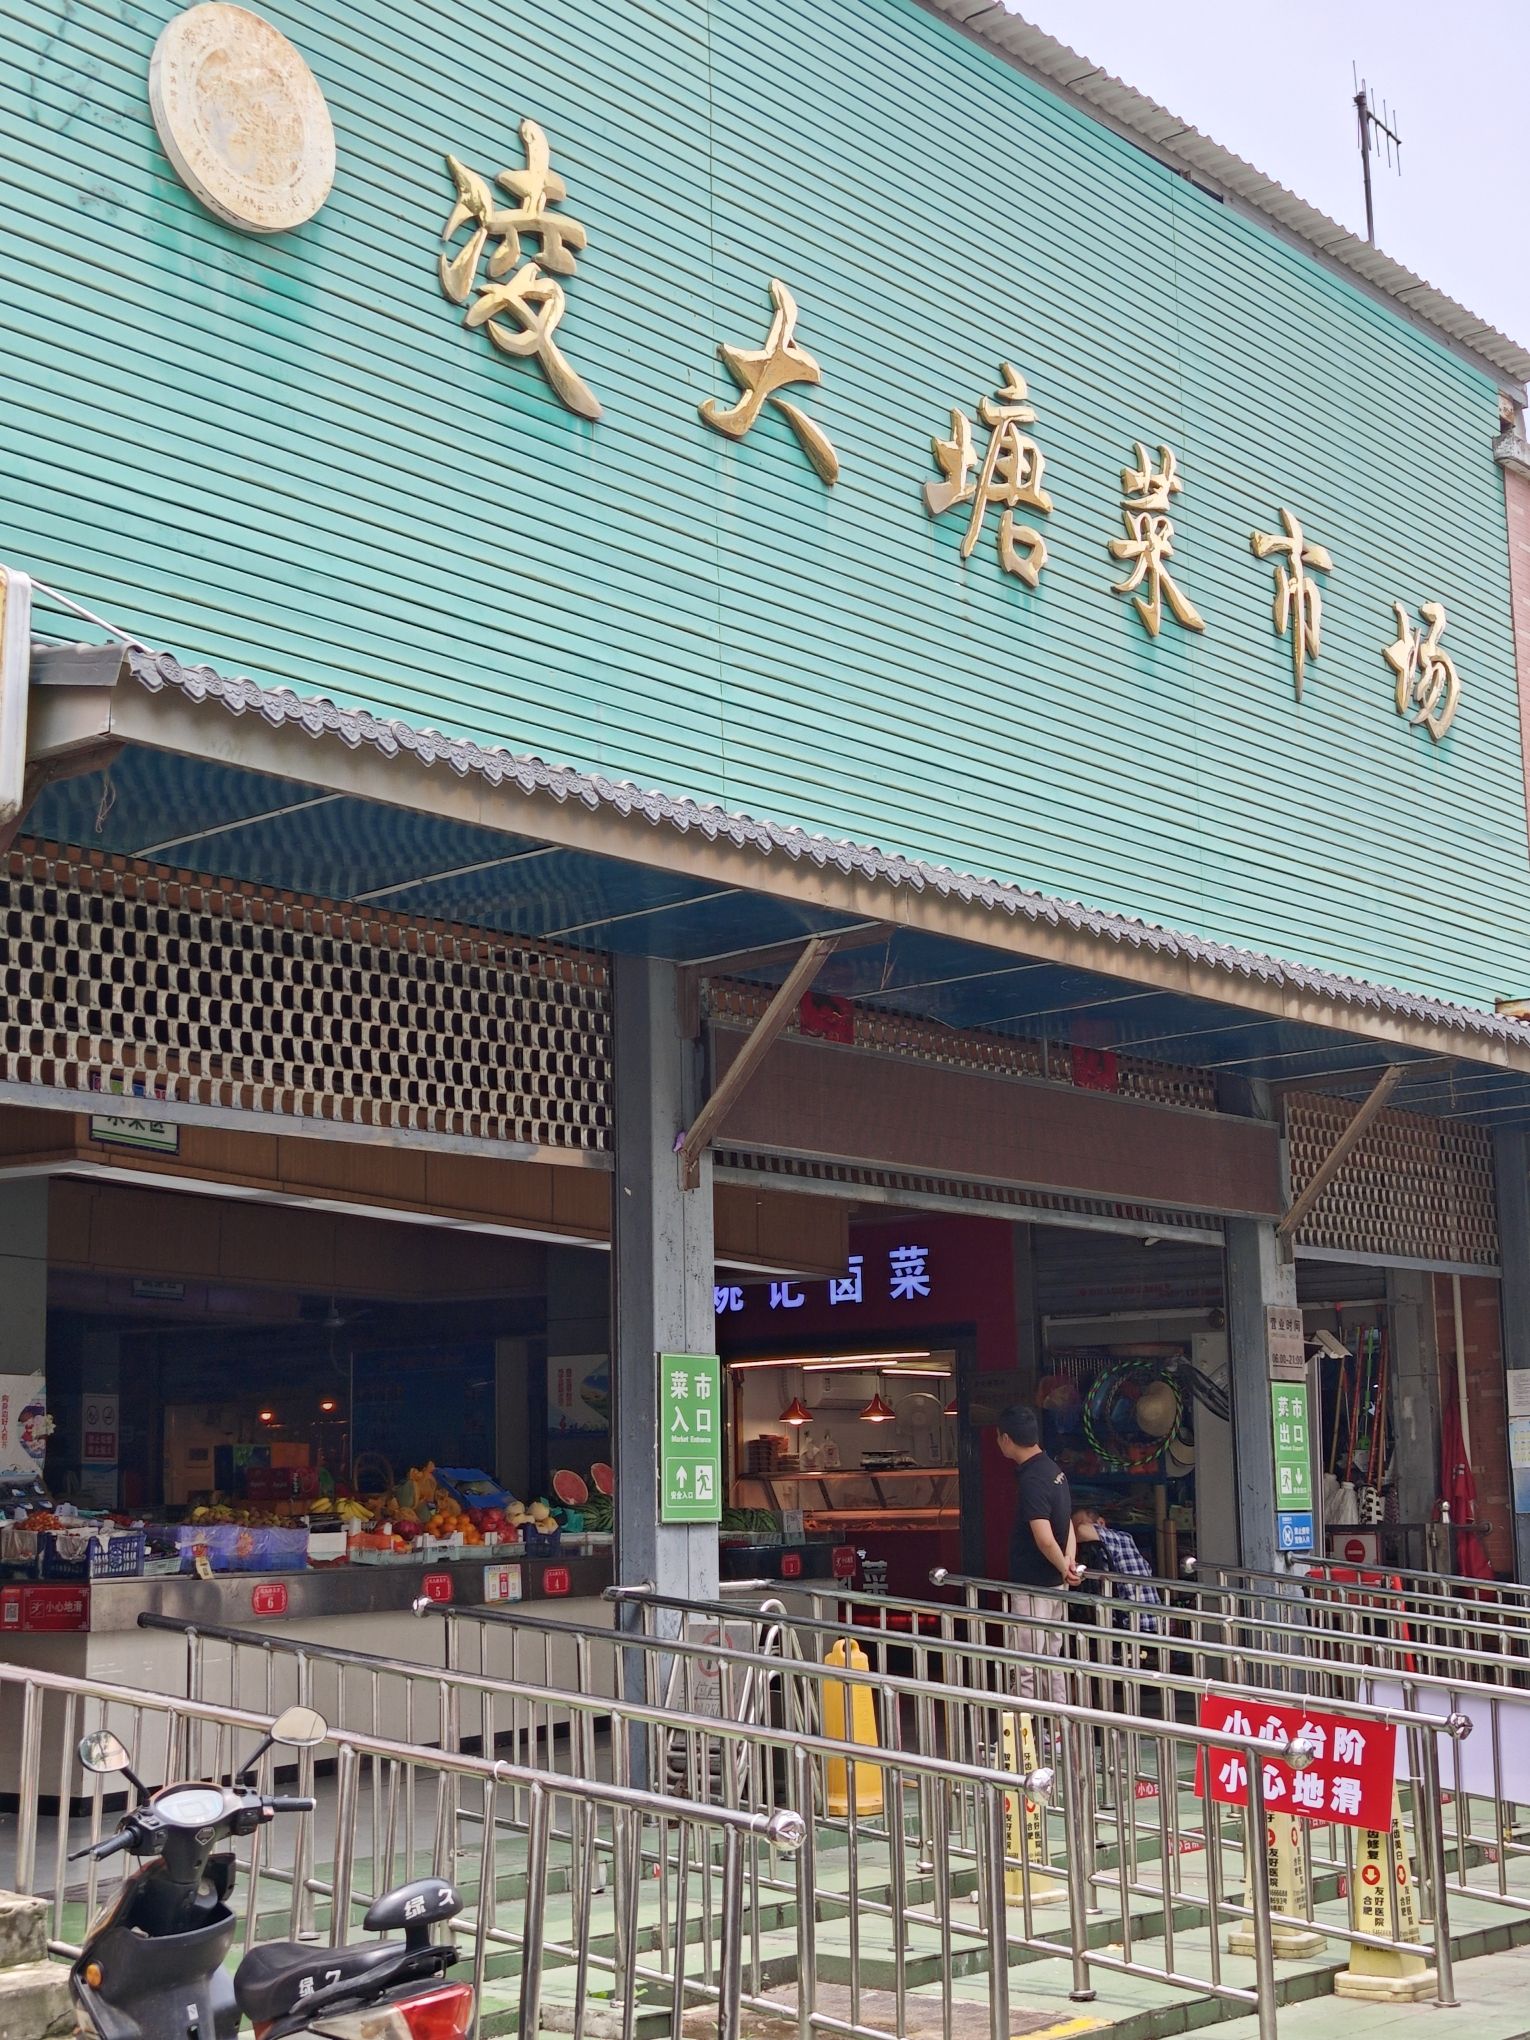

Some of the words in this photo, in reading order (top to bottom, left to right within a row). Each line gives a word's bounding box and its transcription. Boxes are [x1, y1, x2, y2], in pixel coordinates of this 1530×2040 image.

[1269, 1317, 1301, 1332] 营业时间
[670, 1370, 712, 1400] 菜市
[1277, 1396, 1303, 1418] 菜市
[670, 1405, 712, 1433] 入口
[671, 1434, 689, 1443] Market
[1279, 1421, 1304, 1444] 出口
[46, 1600, 83, 1612] 小心地滑
[267, 1597, 274, 1609] 6
[1221, 1709, 1366, 1766] 小心台阶
[1219, 1758, 1362, 1816] 小心地滑
[1268, 1848, 1279, 1887] 友好医院
[1363, 1896, 1373, 1916] 合肥
[1374, 1886, 1385, 1927] 友好医院
